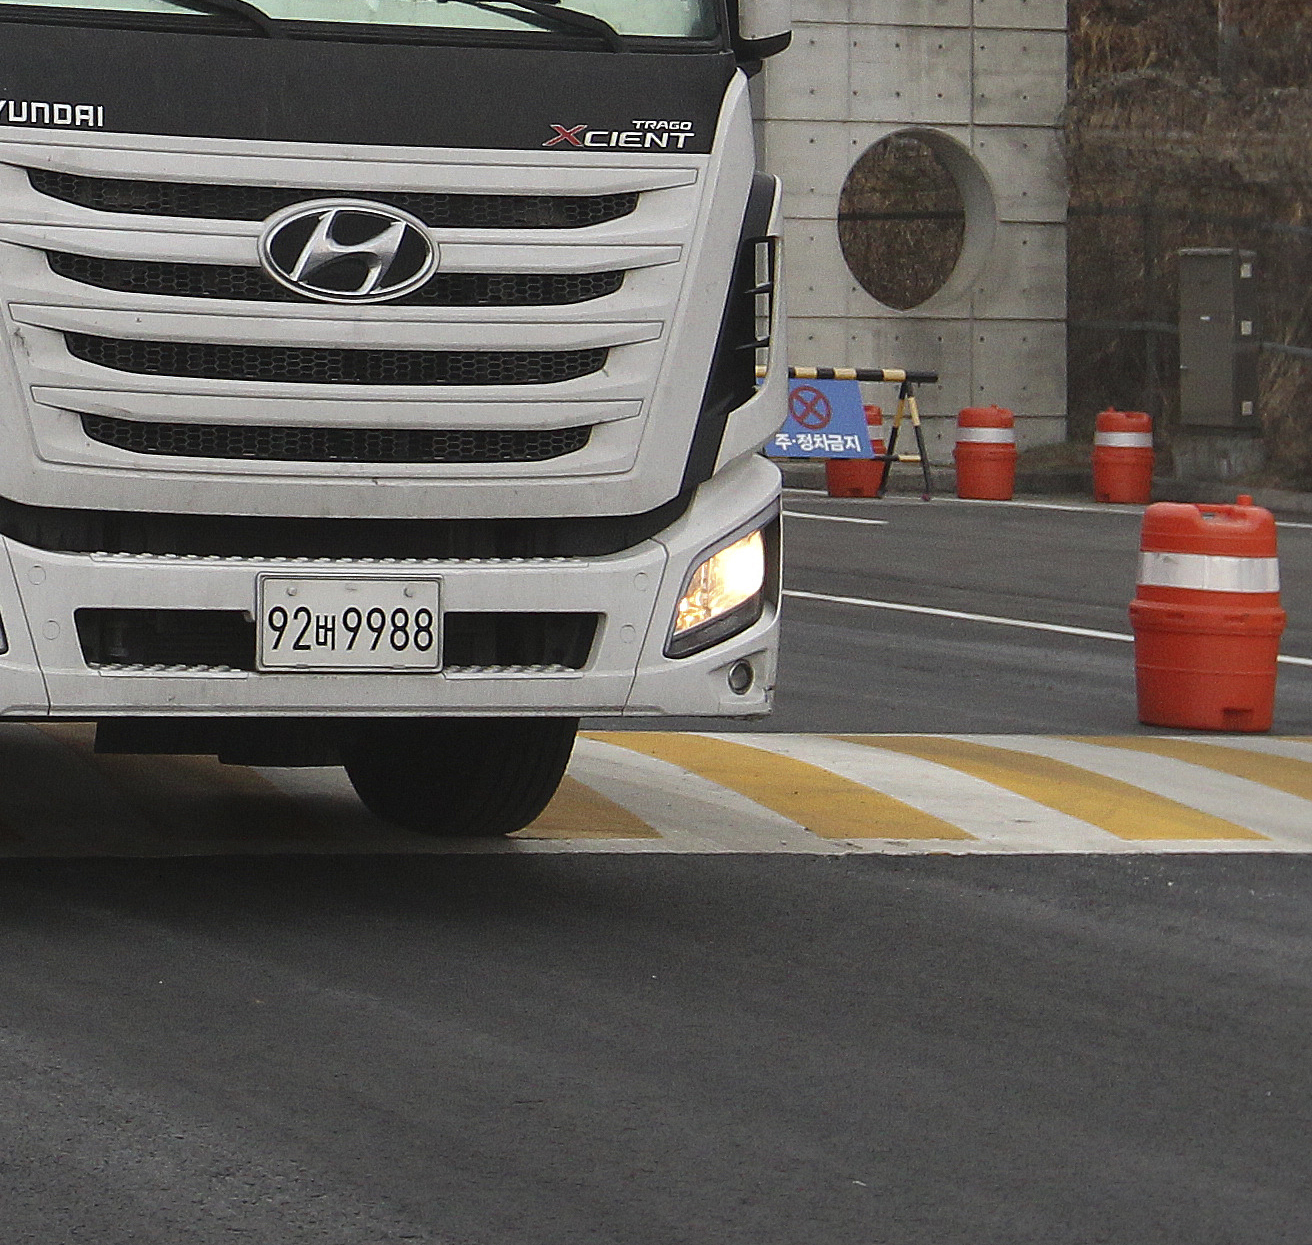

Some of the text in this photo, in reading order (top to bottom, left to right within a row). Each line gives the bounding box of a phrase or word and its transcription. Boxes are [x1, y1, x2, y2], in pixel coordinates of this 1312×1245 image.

[542, 123, 696, 149] XCIENT
[632, 119, 693, 131] TRAGO
[268, 606, 433, 652] 92버9988
